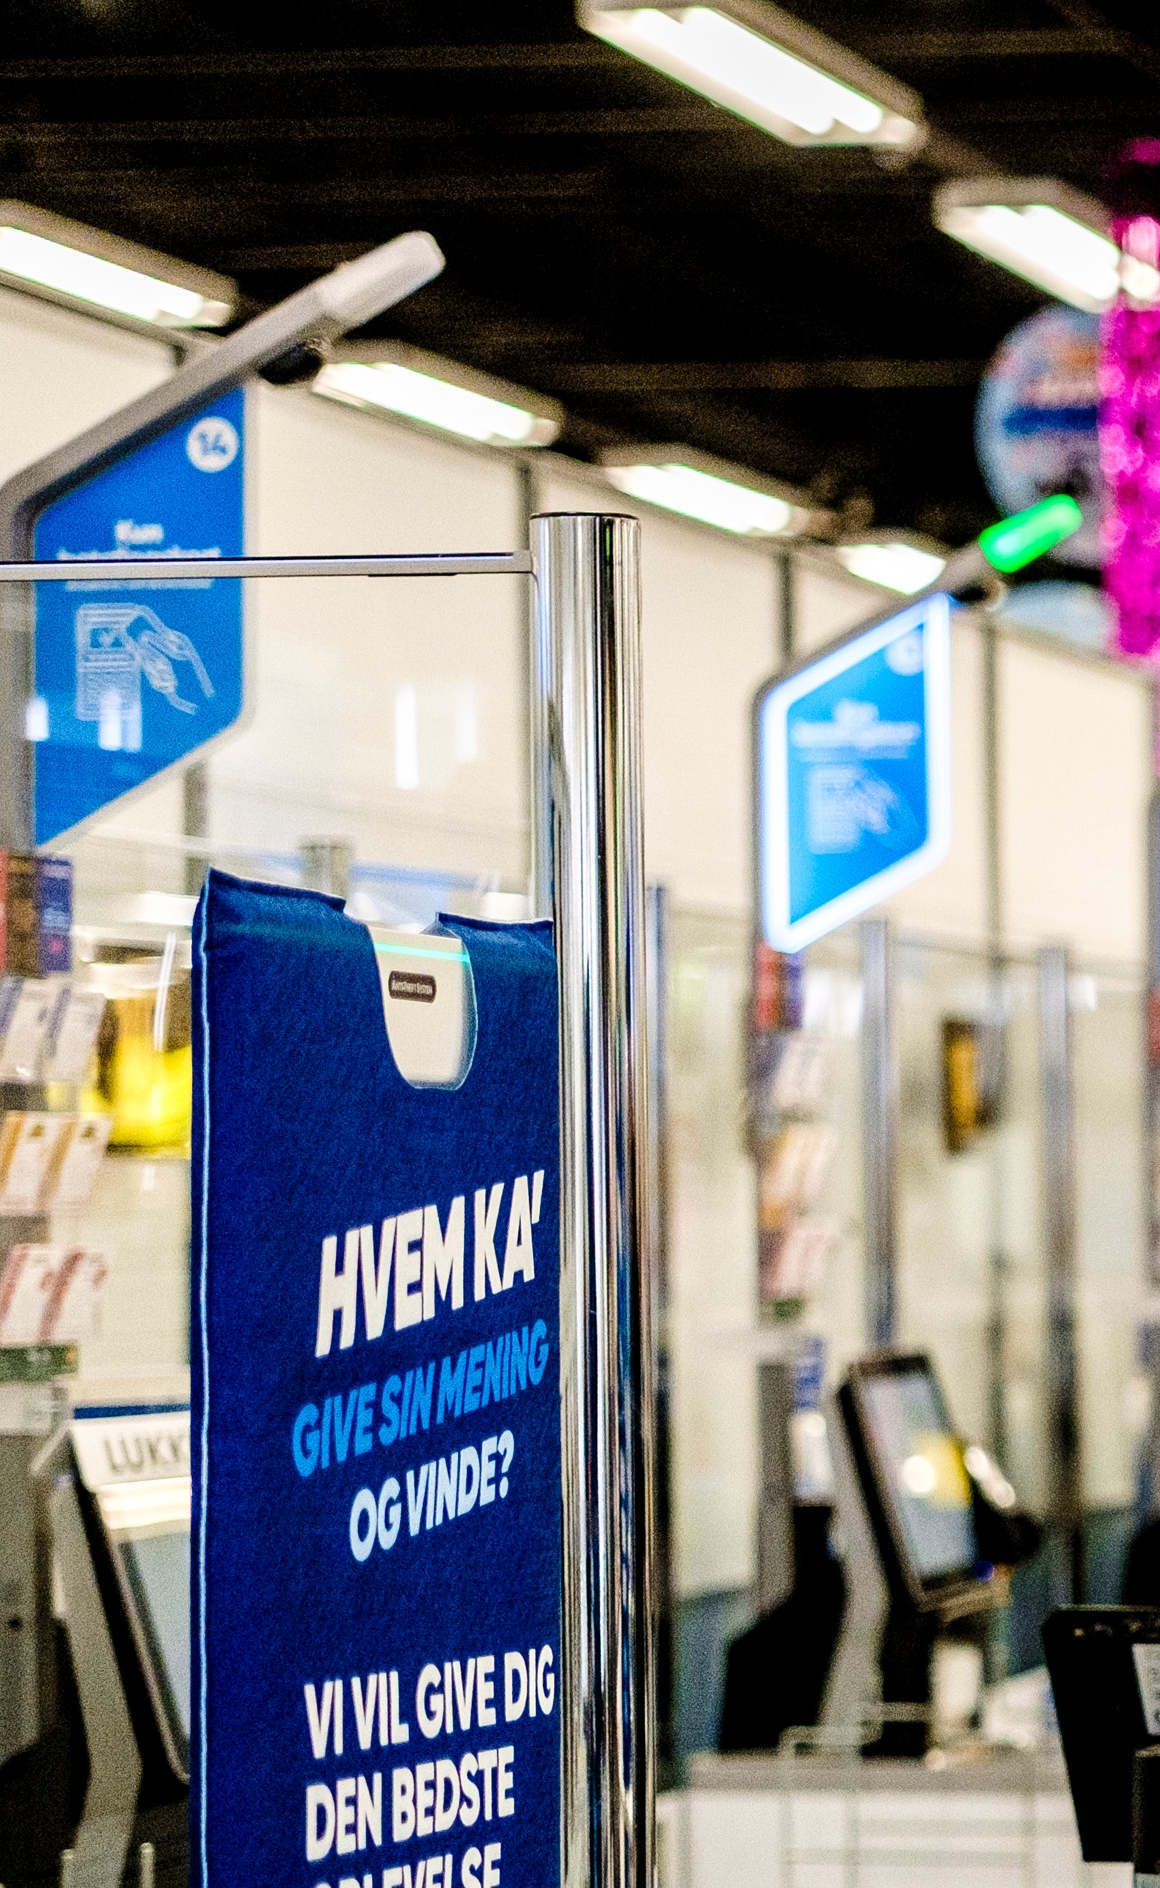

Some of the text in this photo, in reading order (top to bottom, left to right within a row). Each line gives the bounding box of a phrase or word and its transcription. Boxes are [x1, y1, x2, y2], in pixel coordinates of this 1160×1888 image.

[315, 1169, 546, 1359] HVEM KA'
[292, 1318, 550, 1478] GIVE SIN MENING
[349, 1429, 515, 1563] OG VINDE?
[304, 1644, 556, 1760] VI VIL GIVE DIG
[306, 1745, 516, 1863] DEN BEDSTE
